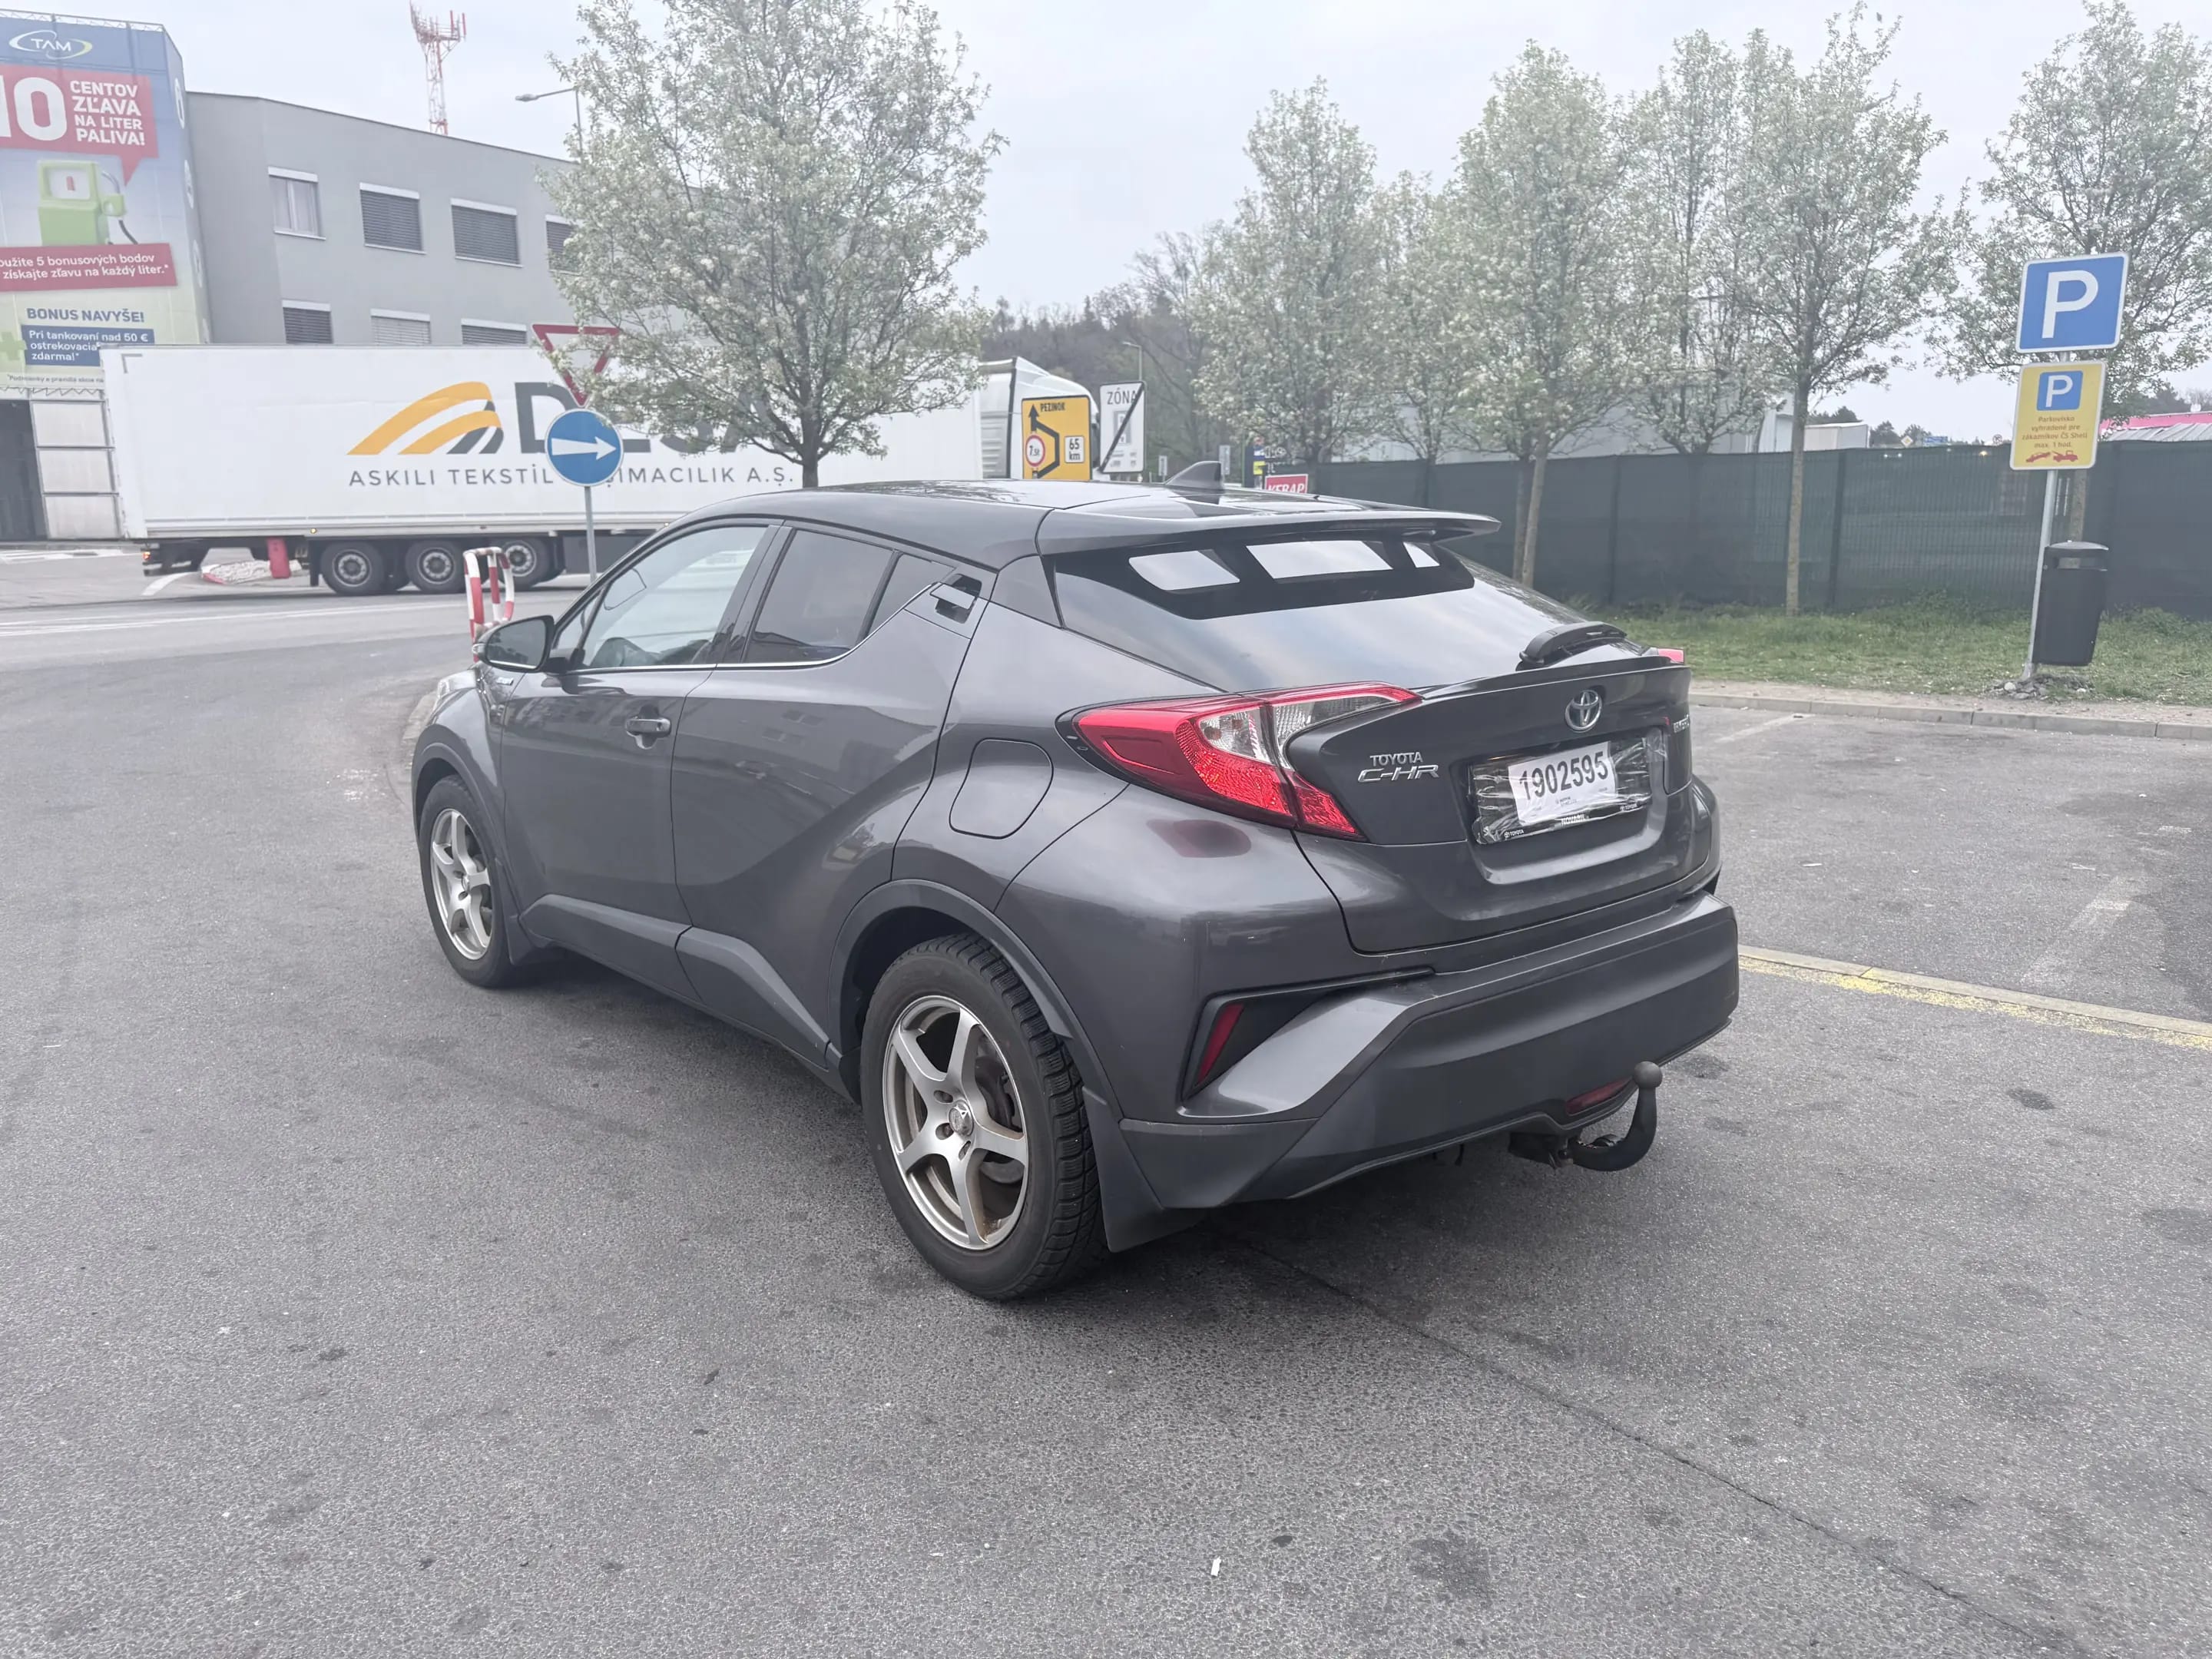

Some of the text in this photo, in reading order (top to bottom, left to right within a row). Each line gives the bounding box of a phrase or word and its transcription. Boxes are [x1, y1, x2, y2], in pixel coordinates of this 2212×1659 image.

[31, 38, 71, 51] TAM
[70, 80, 138, 98] CENTOV
[72, 96, 142, 116] ZĽAVA
[74, 114, 143, 130] NA LITER
[76, 128, 145, 146] PALIVA!
[36, 257, 45, 266] 5
[47, 254, 116, 267] bonusových
[119, 253, 155, 263] bodov
[3, 269, 48, 280] získajte
[101, 266, 136, 278] každý
[2041, 270, 2098, 339] P
[26, 307, 145, 323] BONUS NAVYŠE!
[28, 330, 148, 342] Pri tankovaní nad 50 €
[2045, 375, 2073, 408] P
[1069, 439, 1080, 449] 65
[1069, 451, 1081, 460] km
[349, 469, 435, 486] ASKILI
[448, 464, 553, 485] TEKSTİL
[605, 466, 734, 487] IMACILIK
[1369, 752, 1423, 767] TOYOTA
[1357, 764, 1439, 783] C-HR
[1519, 750, 1610, 800] 1902595
